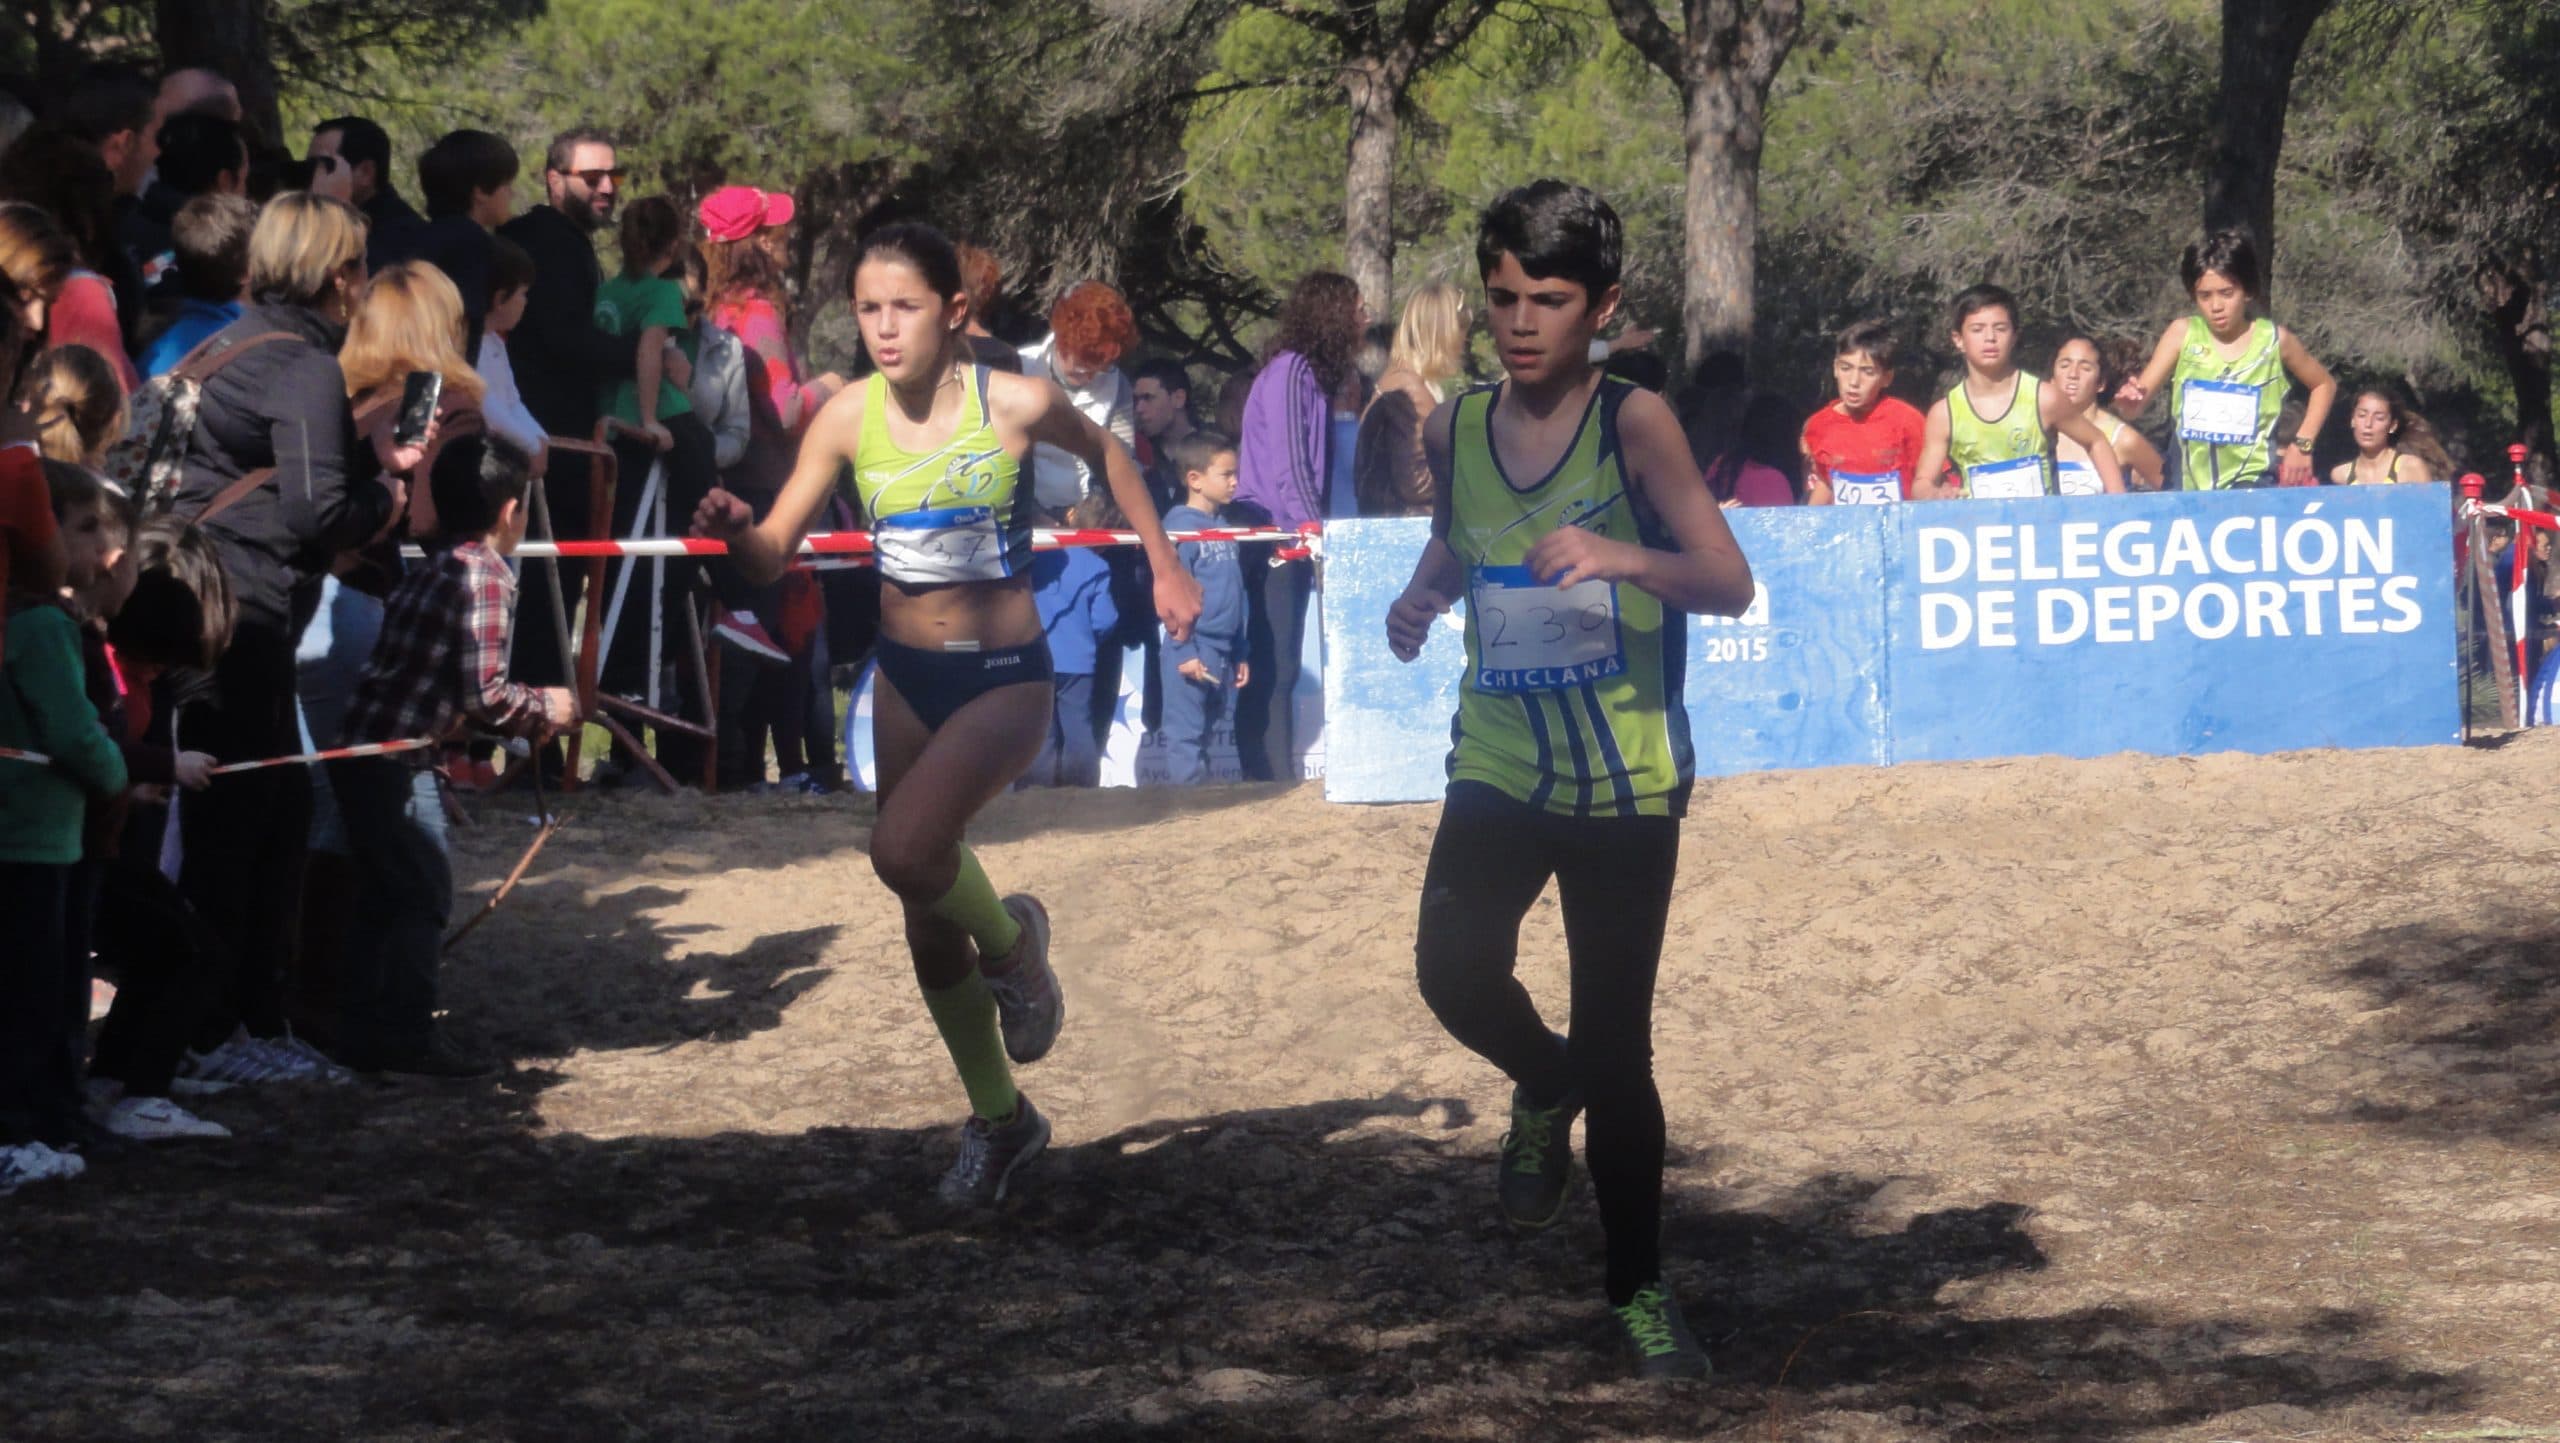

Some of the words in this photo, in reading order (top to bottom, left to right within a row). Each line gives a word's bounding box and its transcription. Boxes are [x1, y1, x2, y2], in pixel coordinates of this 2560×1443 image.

[1918, 503, 2394, 584] DELEGACIÓN
[1485, 603, 1608, 648] 230
[1920, 590, 2016, 650] DE
[2037, 576, 2423, 646] DEPORTES
[1480, 656, 1621, 688] CHICLANA
[1706, 637, 1769, 663] 2015
